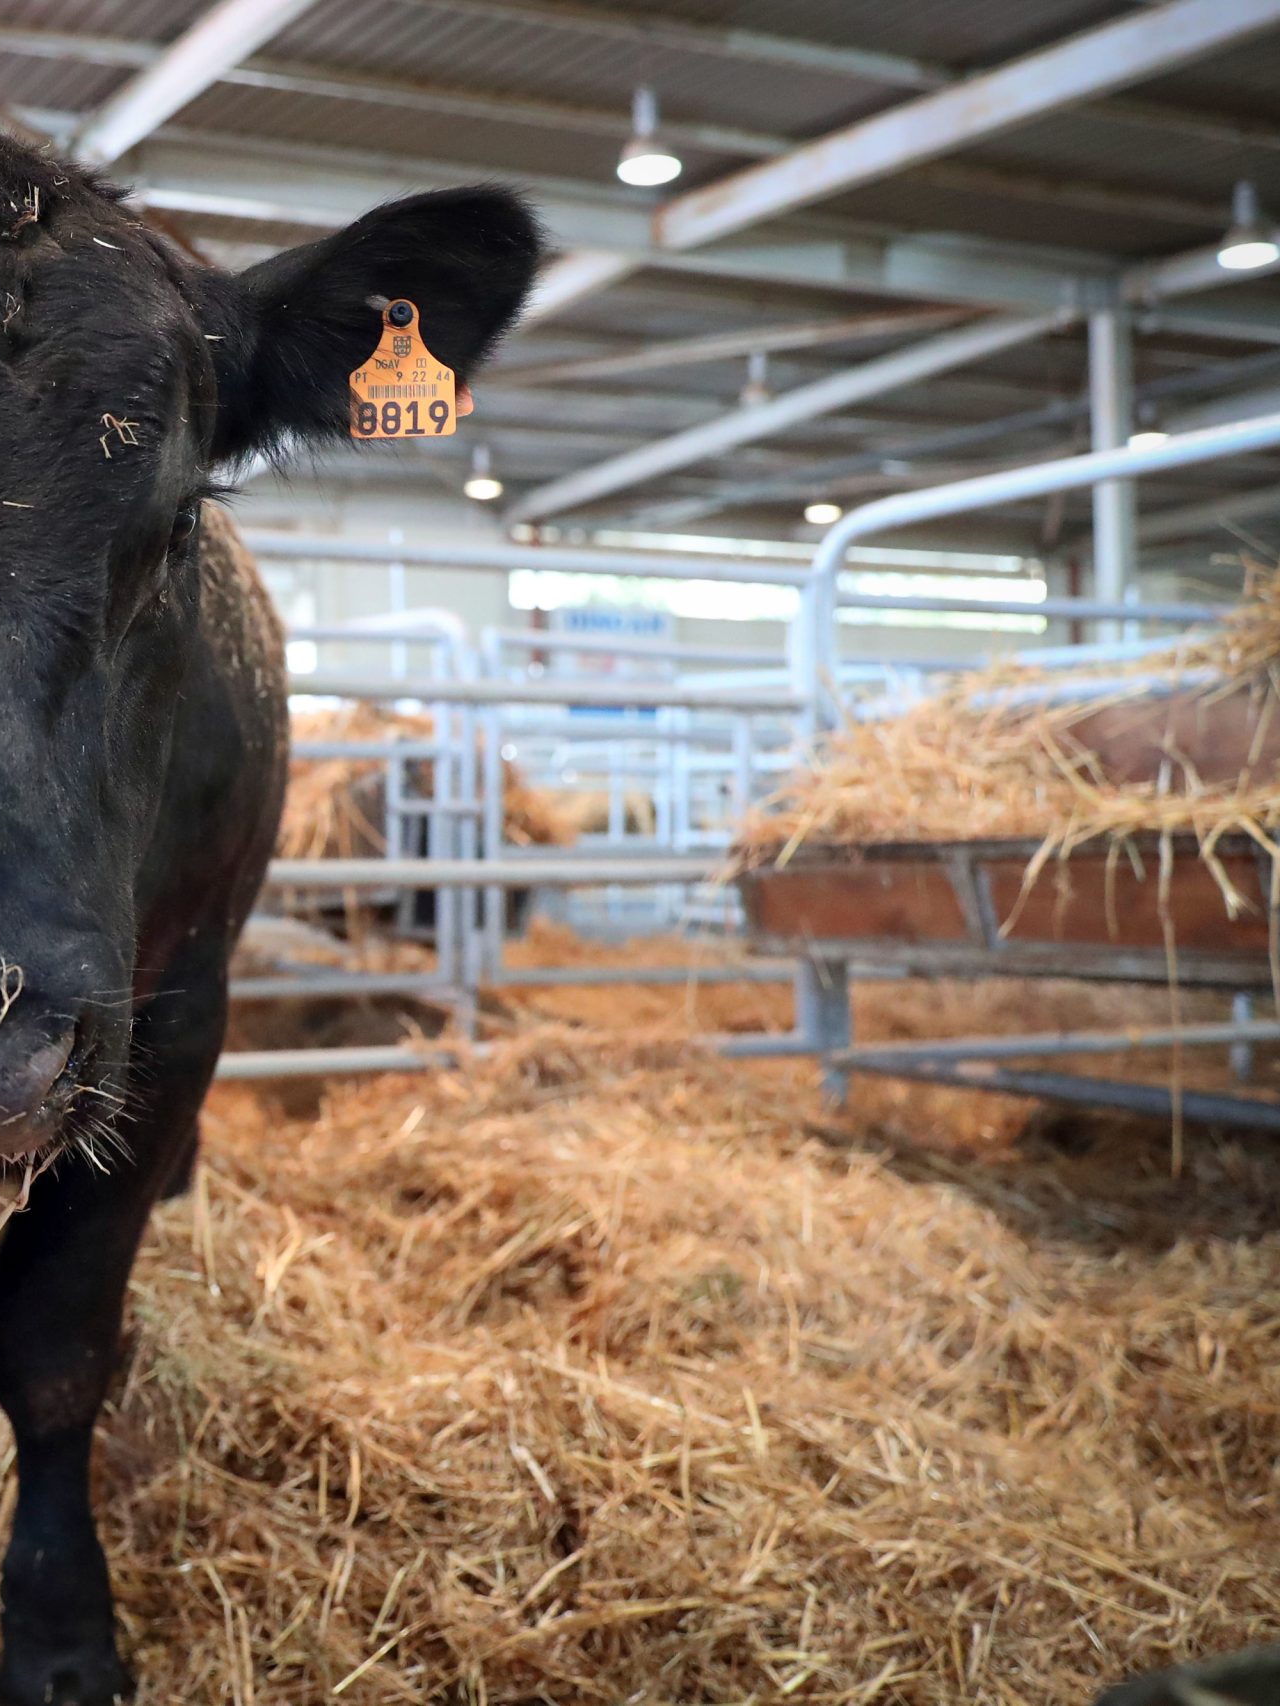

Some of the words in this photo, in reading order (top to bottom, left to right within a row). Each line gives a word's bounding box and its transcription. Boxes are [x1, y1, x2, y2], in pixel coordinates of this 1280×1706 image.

[375, 359, 400, 369] DGAV
[355, 371, 367, 383] PT
[397, 371, 402, 382] 9
[412, 371, 426, 382] 22
[436, 370, 450, 381] 44
[358, 400, 448, 435] 8819
